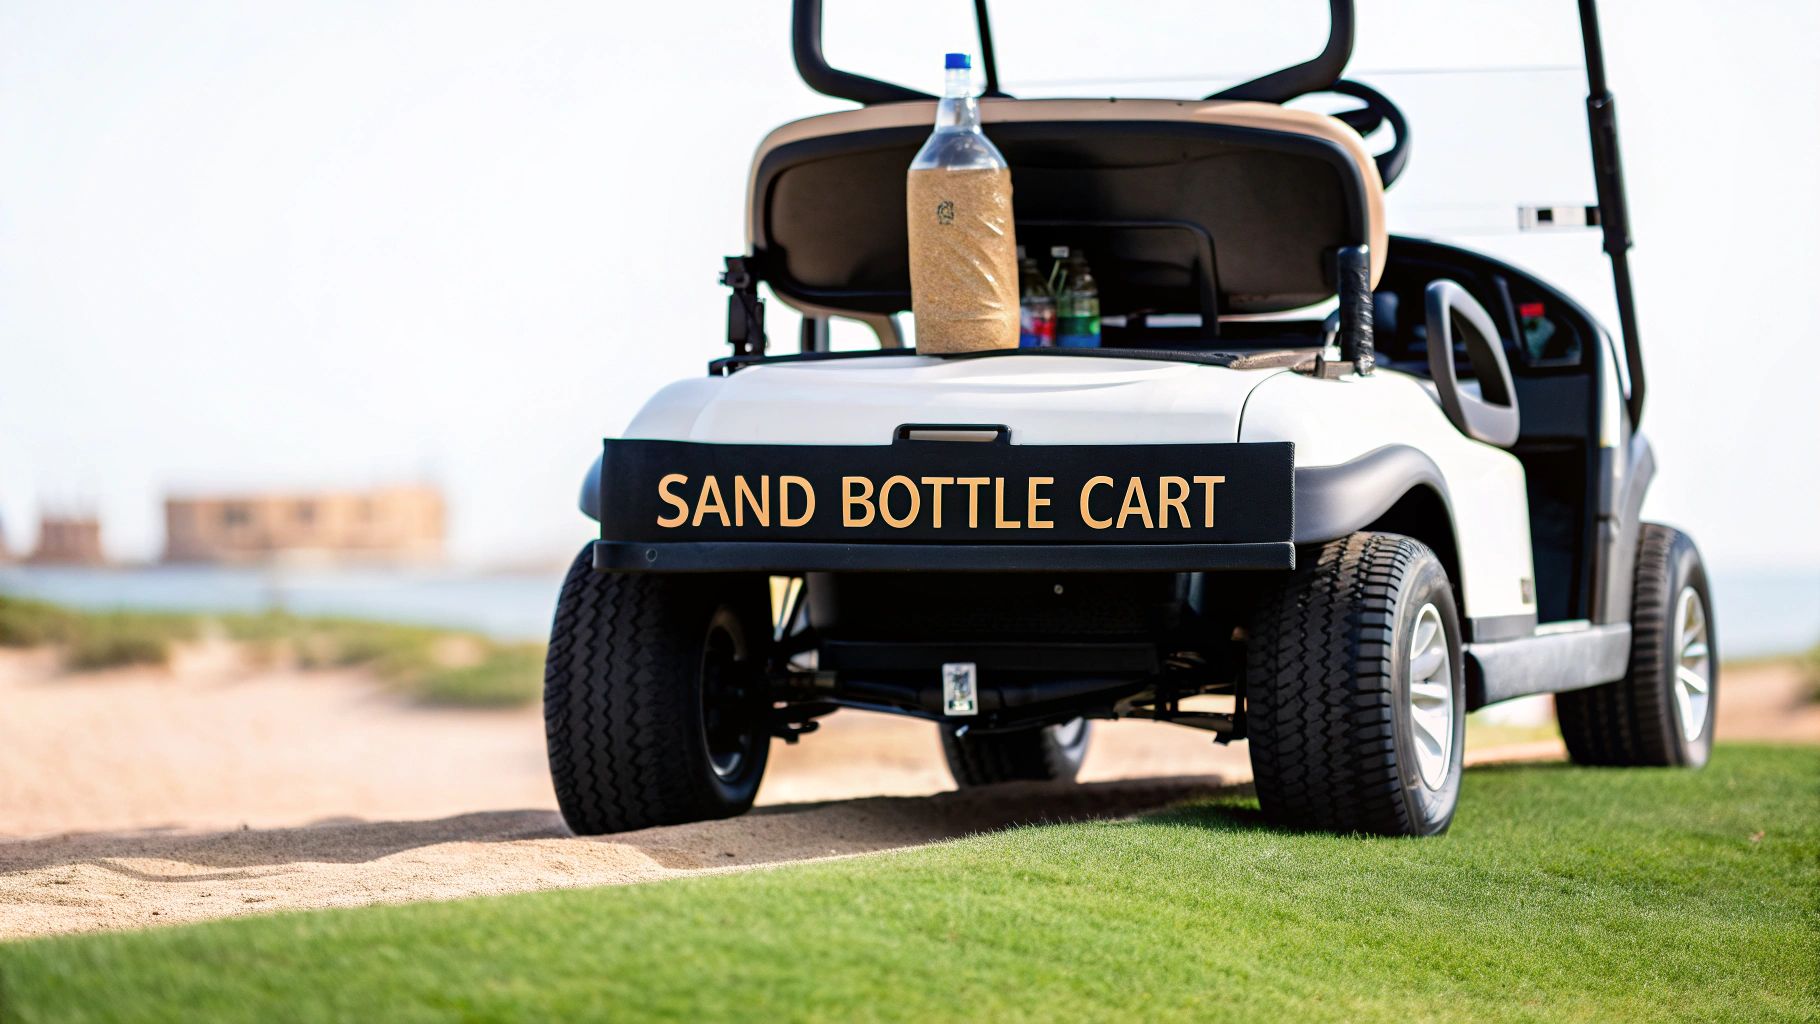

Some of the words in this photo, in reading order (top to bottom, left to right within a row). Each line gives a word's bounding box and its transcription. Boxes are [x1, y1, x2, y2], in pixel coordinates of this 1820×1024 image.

[656, 473, 816, 528] SAND
[841, 475, 1055, 529] BOTTLE
[1079, 475, 1226, 529] CART
